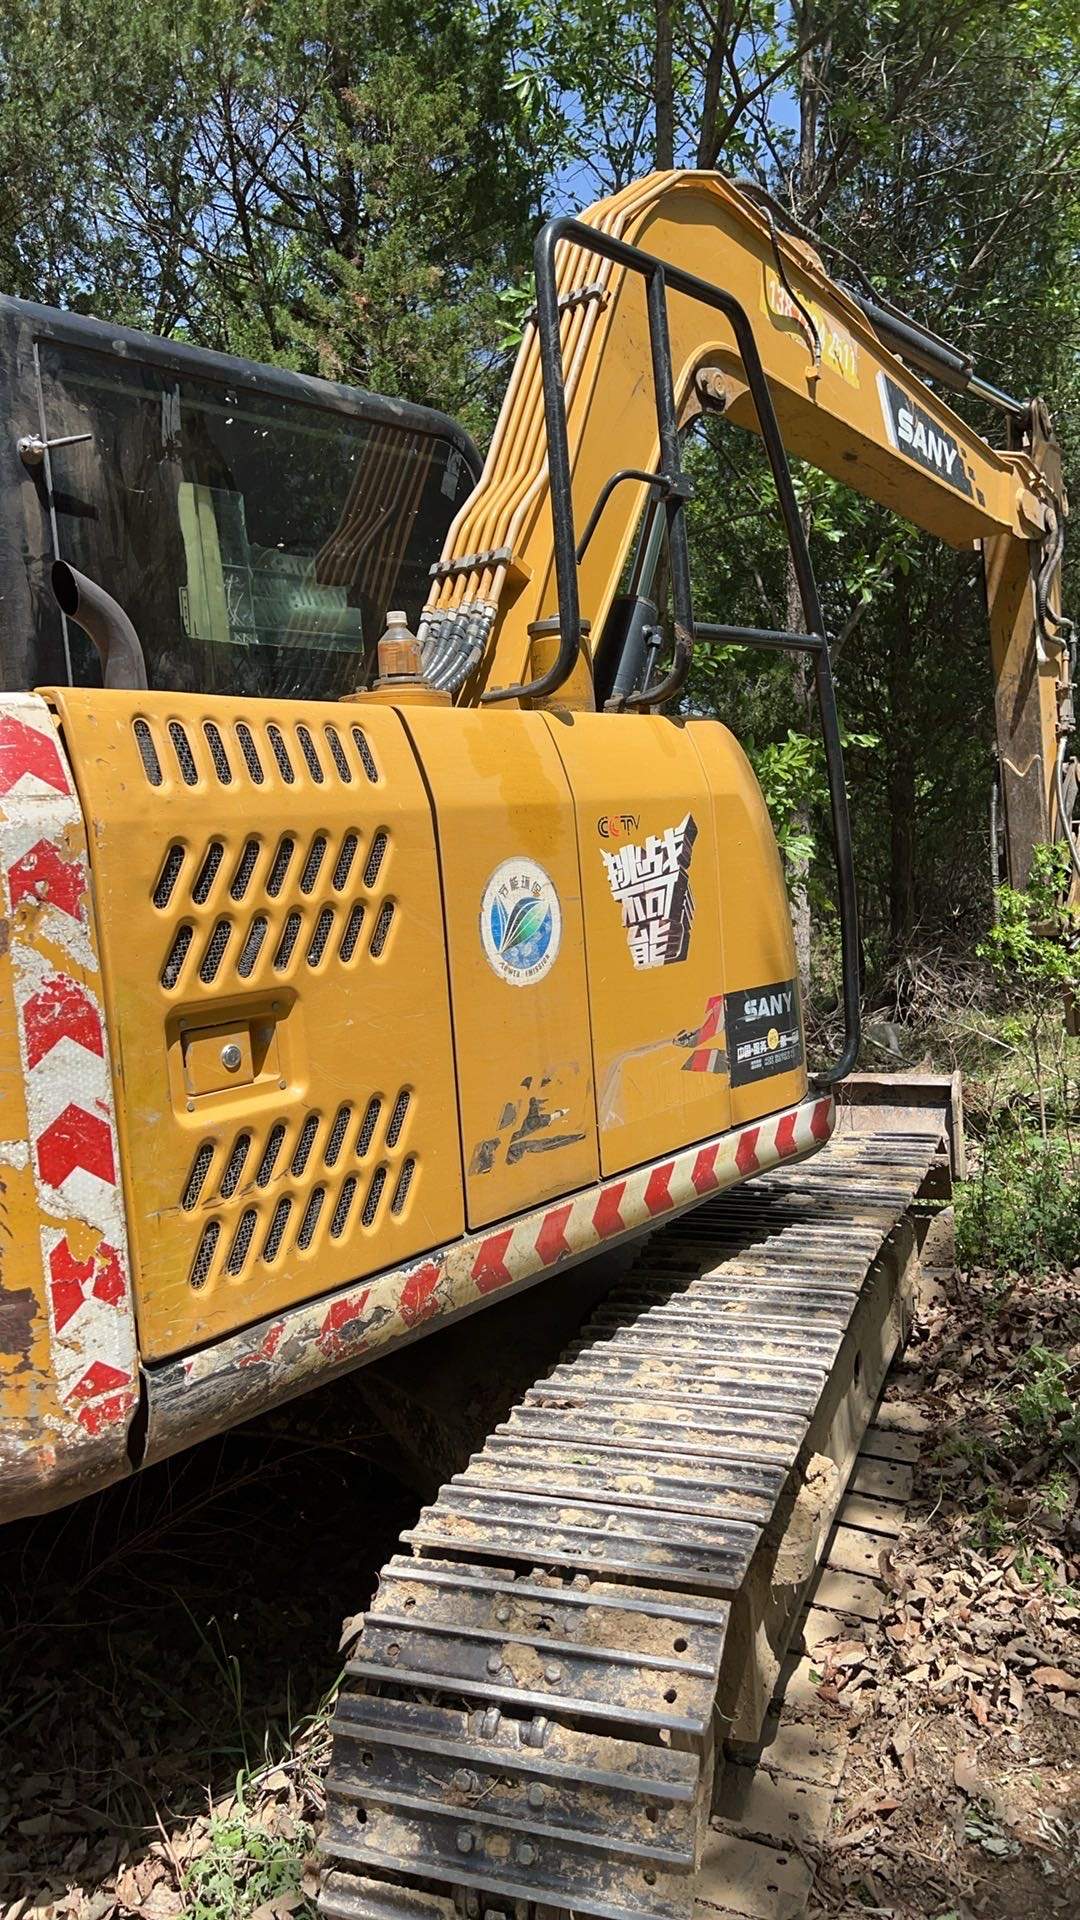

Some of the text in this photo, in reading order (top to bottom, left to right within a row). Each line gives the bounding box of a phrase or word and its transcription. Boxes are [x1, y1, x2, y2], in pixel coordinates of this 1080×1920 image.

[898, 407, 957, 475] SANY
[597, 814, 640, 838] CCTV
[599, 811, 692, 891] 挑战
[611, 871, 680, 926] 不可
[627, 918, 672, 971] 能
[744, 991, 792, 1022] SANY
